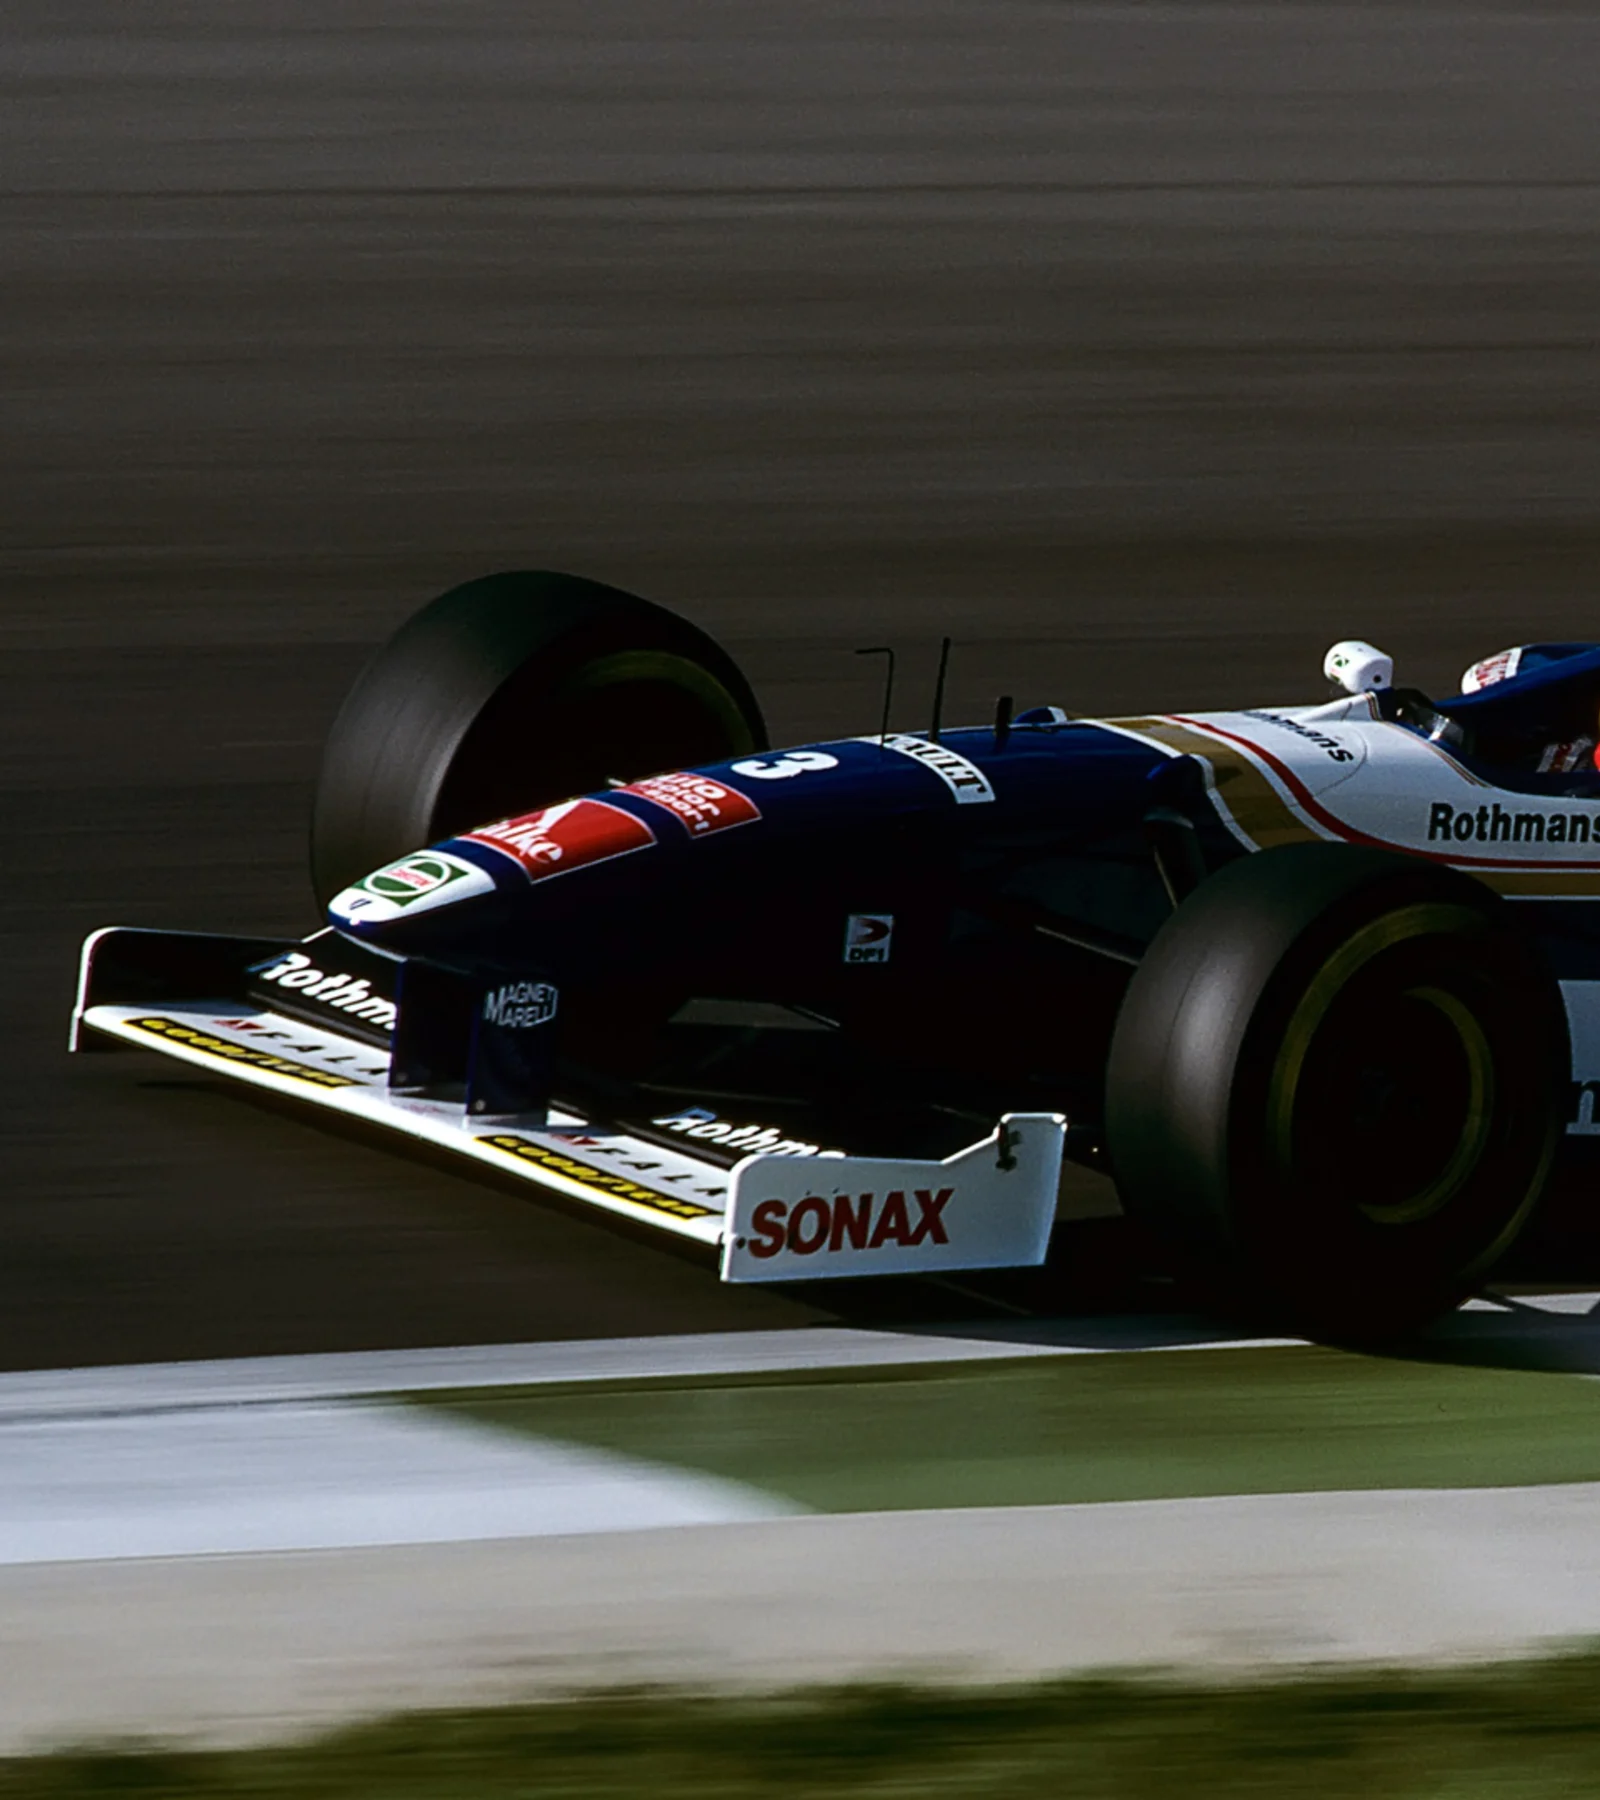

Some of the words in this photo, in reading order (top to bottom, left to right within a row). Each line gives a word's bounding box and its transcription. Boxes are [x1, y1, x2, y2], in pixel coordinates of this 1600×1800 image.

[730, 751, 840, 779] 3
[247, 952, 398, 1031] Rothm
[749, 1188, 954, 1259] SONAX
